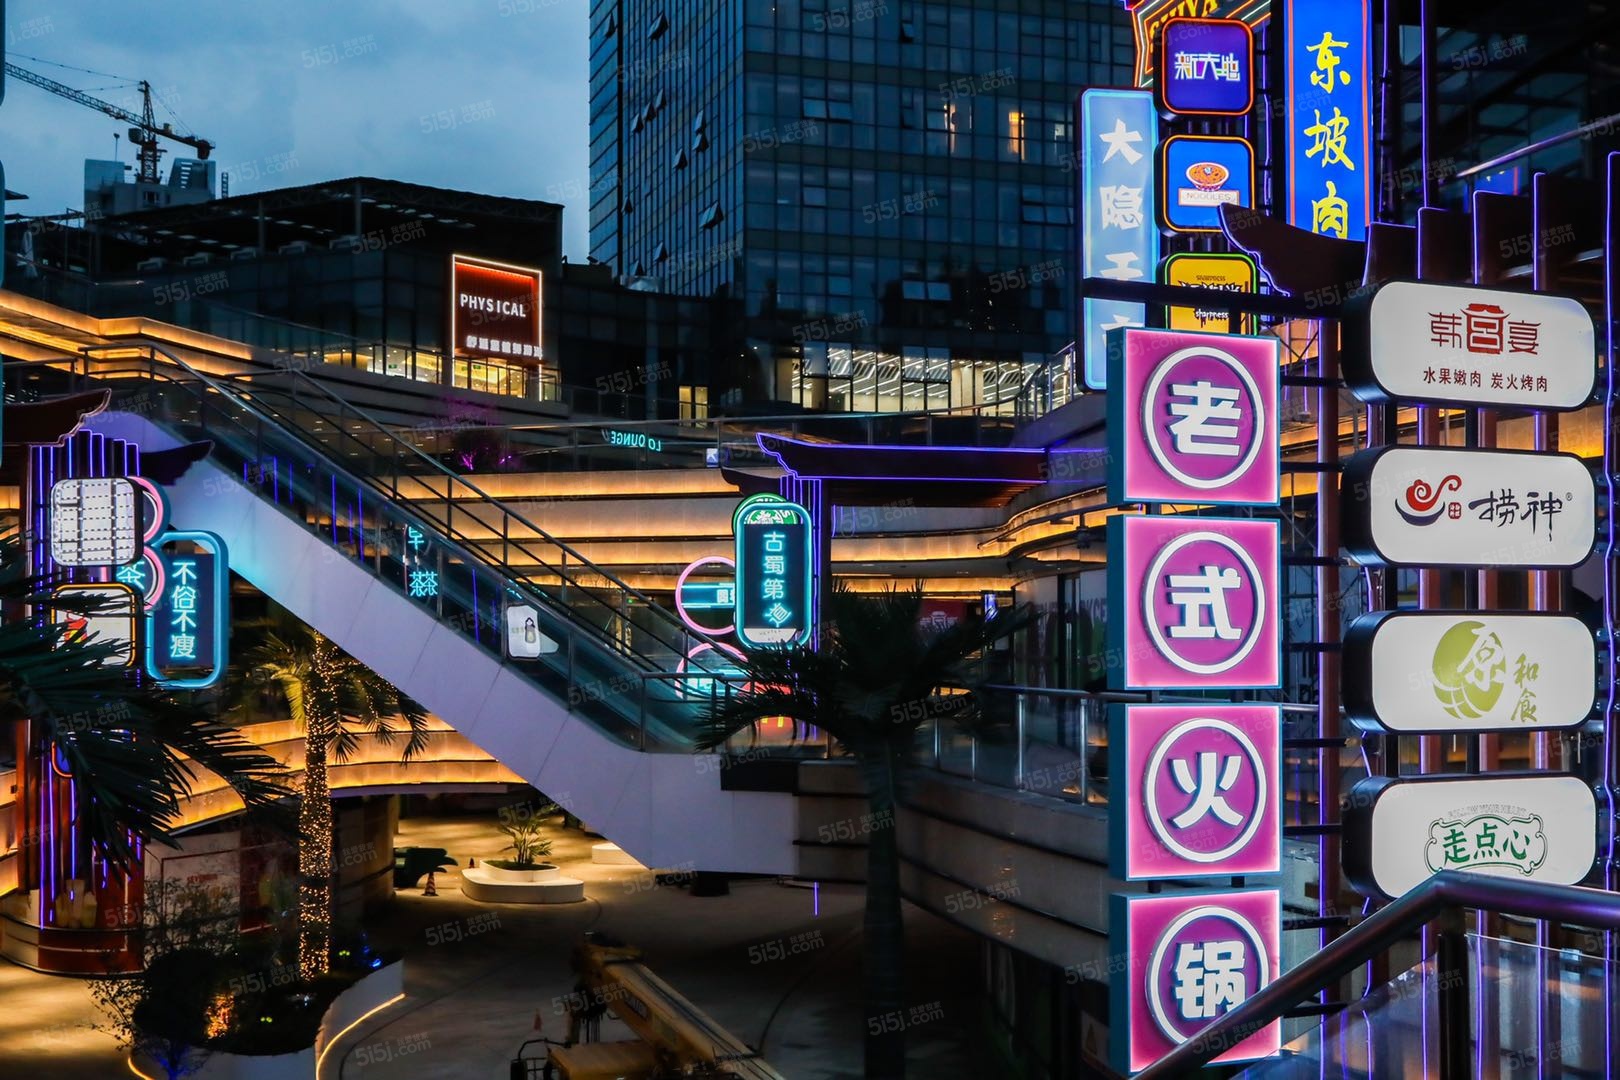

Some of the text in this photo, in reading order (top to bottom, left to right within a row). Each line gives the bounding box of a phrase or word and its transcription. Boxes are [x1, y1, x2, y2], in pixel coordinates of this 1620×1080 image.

[1174, 51, 1241, 81] 新天地
[1303, 31, 1355, 241] 东坡肉
[1186, 190, 1231, 201] NOODLES
[460, 293, 526, 318] PHYSICAL
[1428, 303, 1541, 355] 韩宫宴
[1423, 366, 1548, 393] 水果嫩肉 炭火烤肉
[1468, 488, 1563, 541] 捞神
[170, 561, 198, 659] 不俗不瘦
[1443, 822, 1530, 866] 走点心
